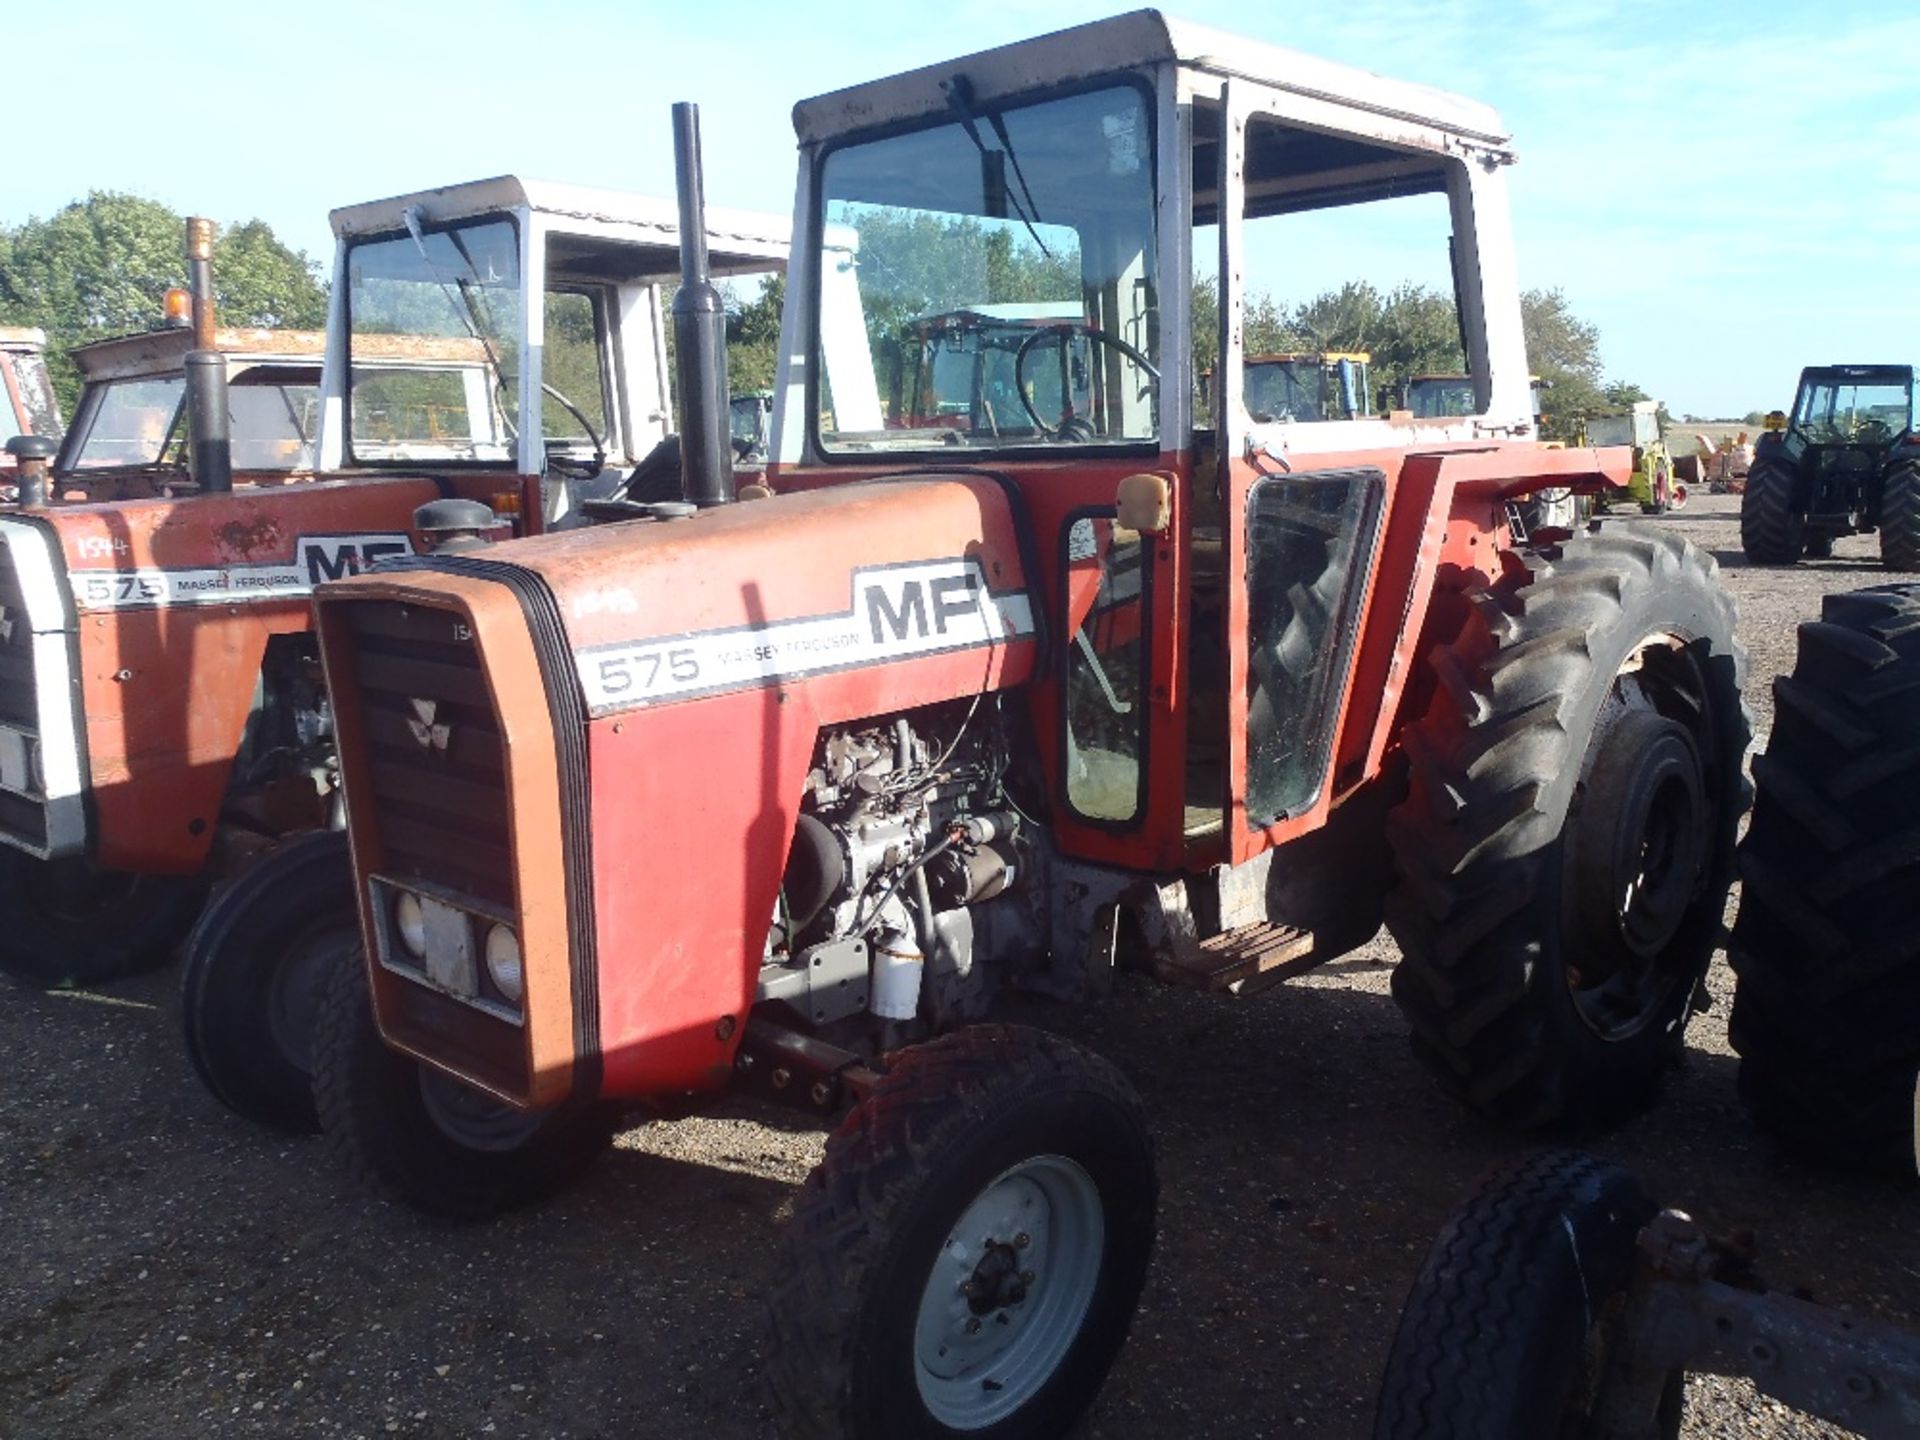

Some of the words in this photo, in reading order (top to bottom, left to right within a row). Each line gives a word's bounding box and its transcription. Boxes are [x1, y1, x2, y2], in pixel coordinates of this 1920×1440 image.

[78, 536, 129, 559] 1544
[87, 577, 164, 600] 575
[235, 575, 299, 589] FERGUSON
[864, 572, 979, 645] MF
[599, 648, 700, 695] 575
[786, 633, 860, 652] FERGUSON
